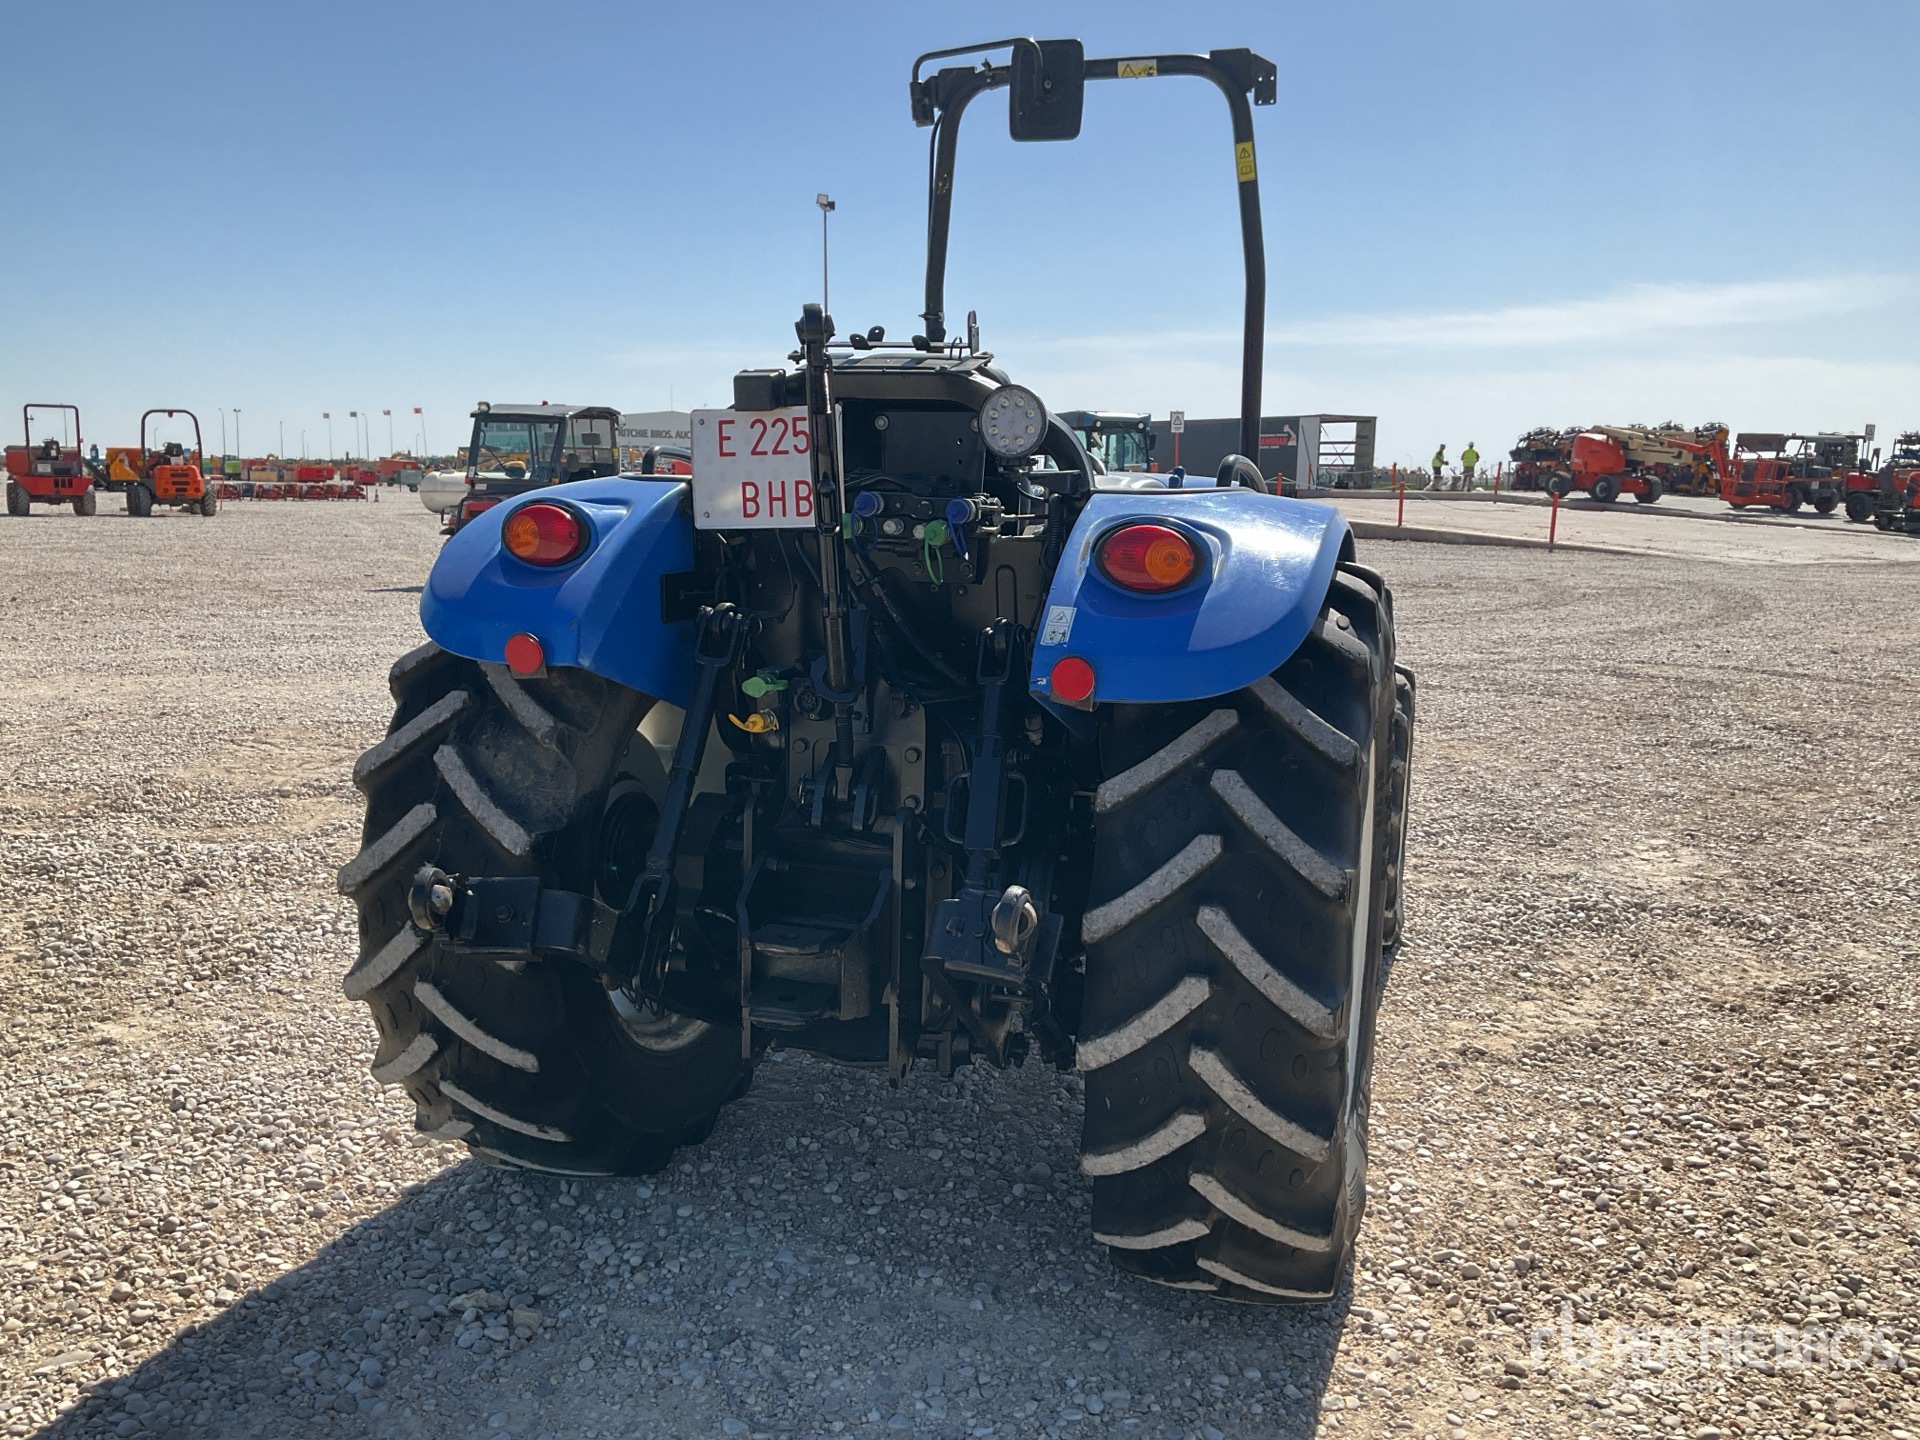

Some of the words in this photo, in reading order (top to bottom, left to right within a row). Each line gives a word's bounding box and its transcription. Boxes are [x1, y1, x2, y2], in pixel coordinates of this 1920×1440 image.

[618, 428, 649, 439] RITCHIE
[650, 429, 673, 439] BROS.
[718, 419, 736, 457] E
[750, 417, 809, 456] 225
[742, 480, 813, 518] BHB
